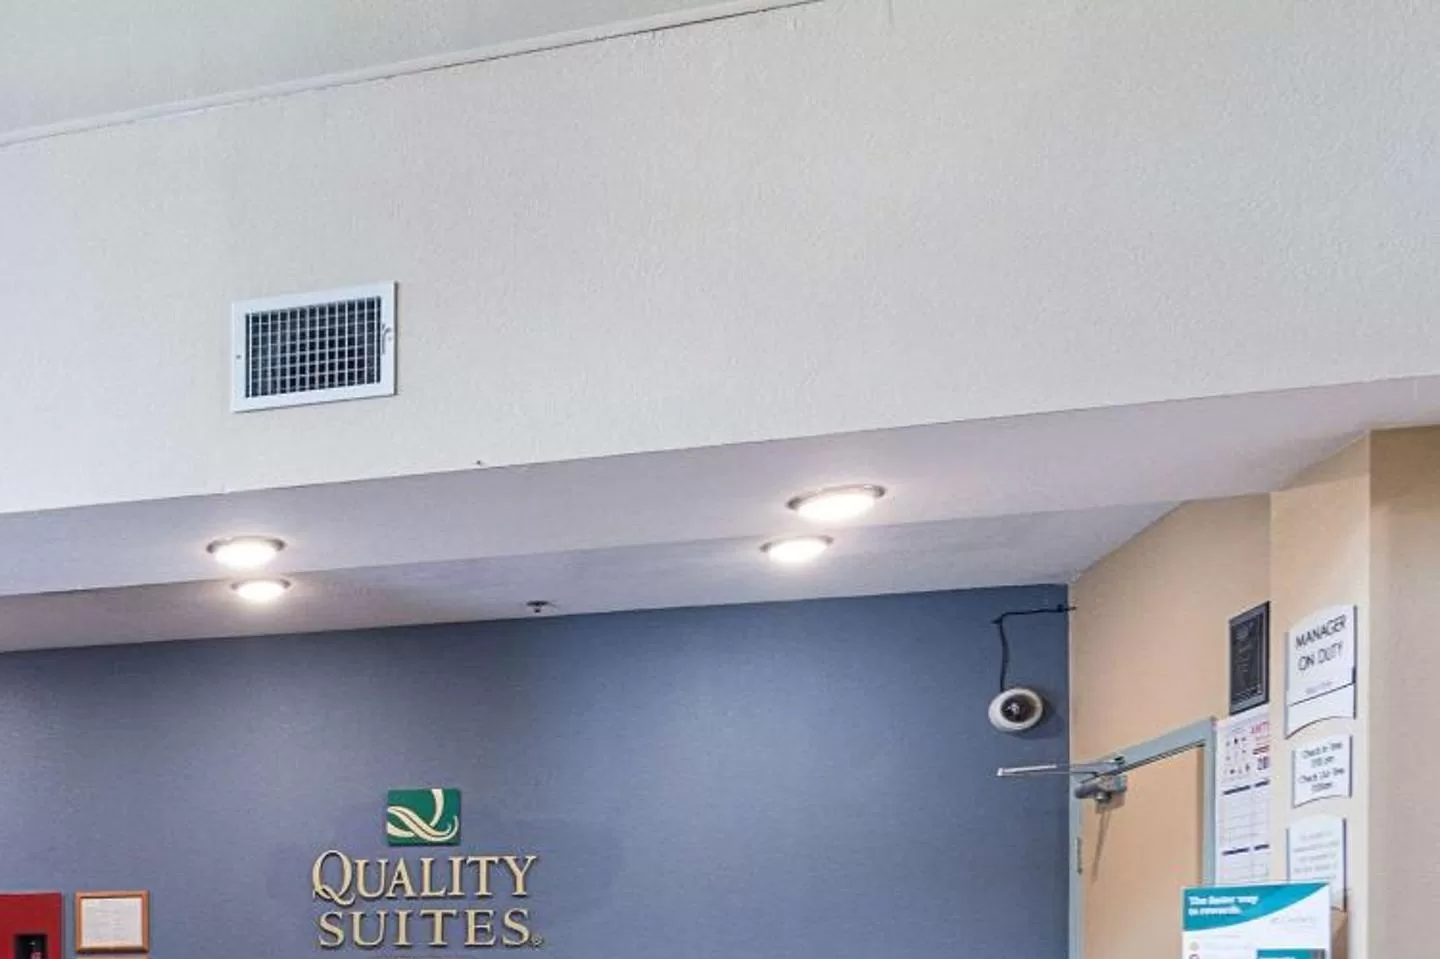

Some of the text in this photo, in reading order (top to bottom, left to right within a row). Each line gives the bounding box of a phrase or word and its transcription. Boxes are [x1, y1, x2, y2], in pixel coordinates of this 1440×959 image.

[1294, 614, 1346, 648] MANAGER
[1298, 640, 1344, 671] ON DUTY
[312, 850, 537, 906] QUALITY
